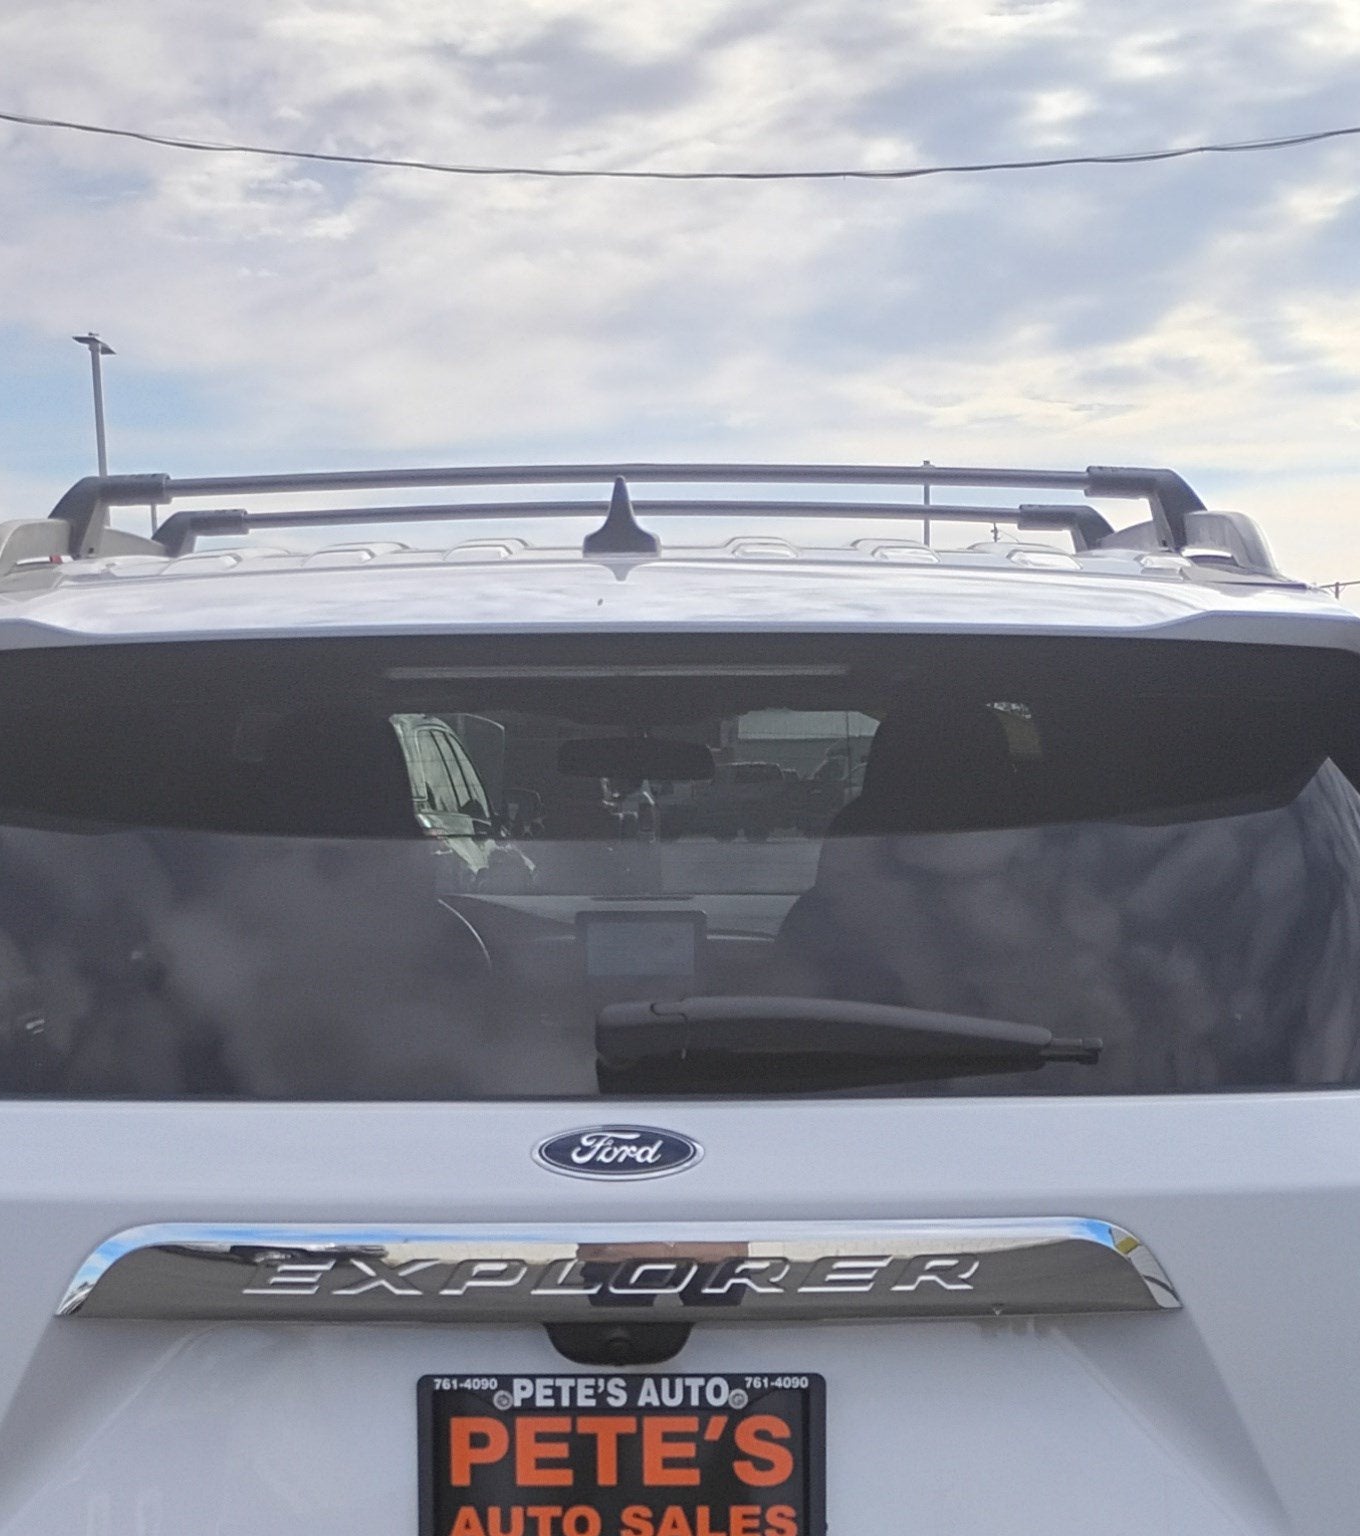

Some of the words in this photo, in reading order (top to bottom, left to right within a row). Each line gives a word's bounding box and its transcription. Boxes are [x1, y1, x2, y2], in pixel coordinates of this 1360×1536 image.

[571, 1132, 663, 1164] Ford
[243, 1254, 981, 1297] EXPLORER
[433, 1378, 498, 1391] 761-4090
[512, 1377, 627, 1409] PETE'S
[638, 1377, 730, 1409] AUTO
[744, 1376, 809, 1389] 761-4090
[450, 1416, 794, 1487] PETE'S
